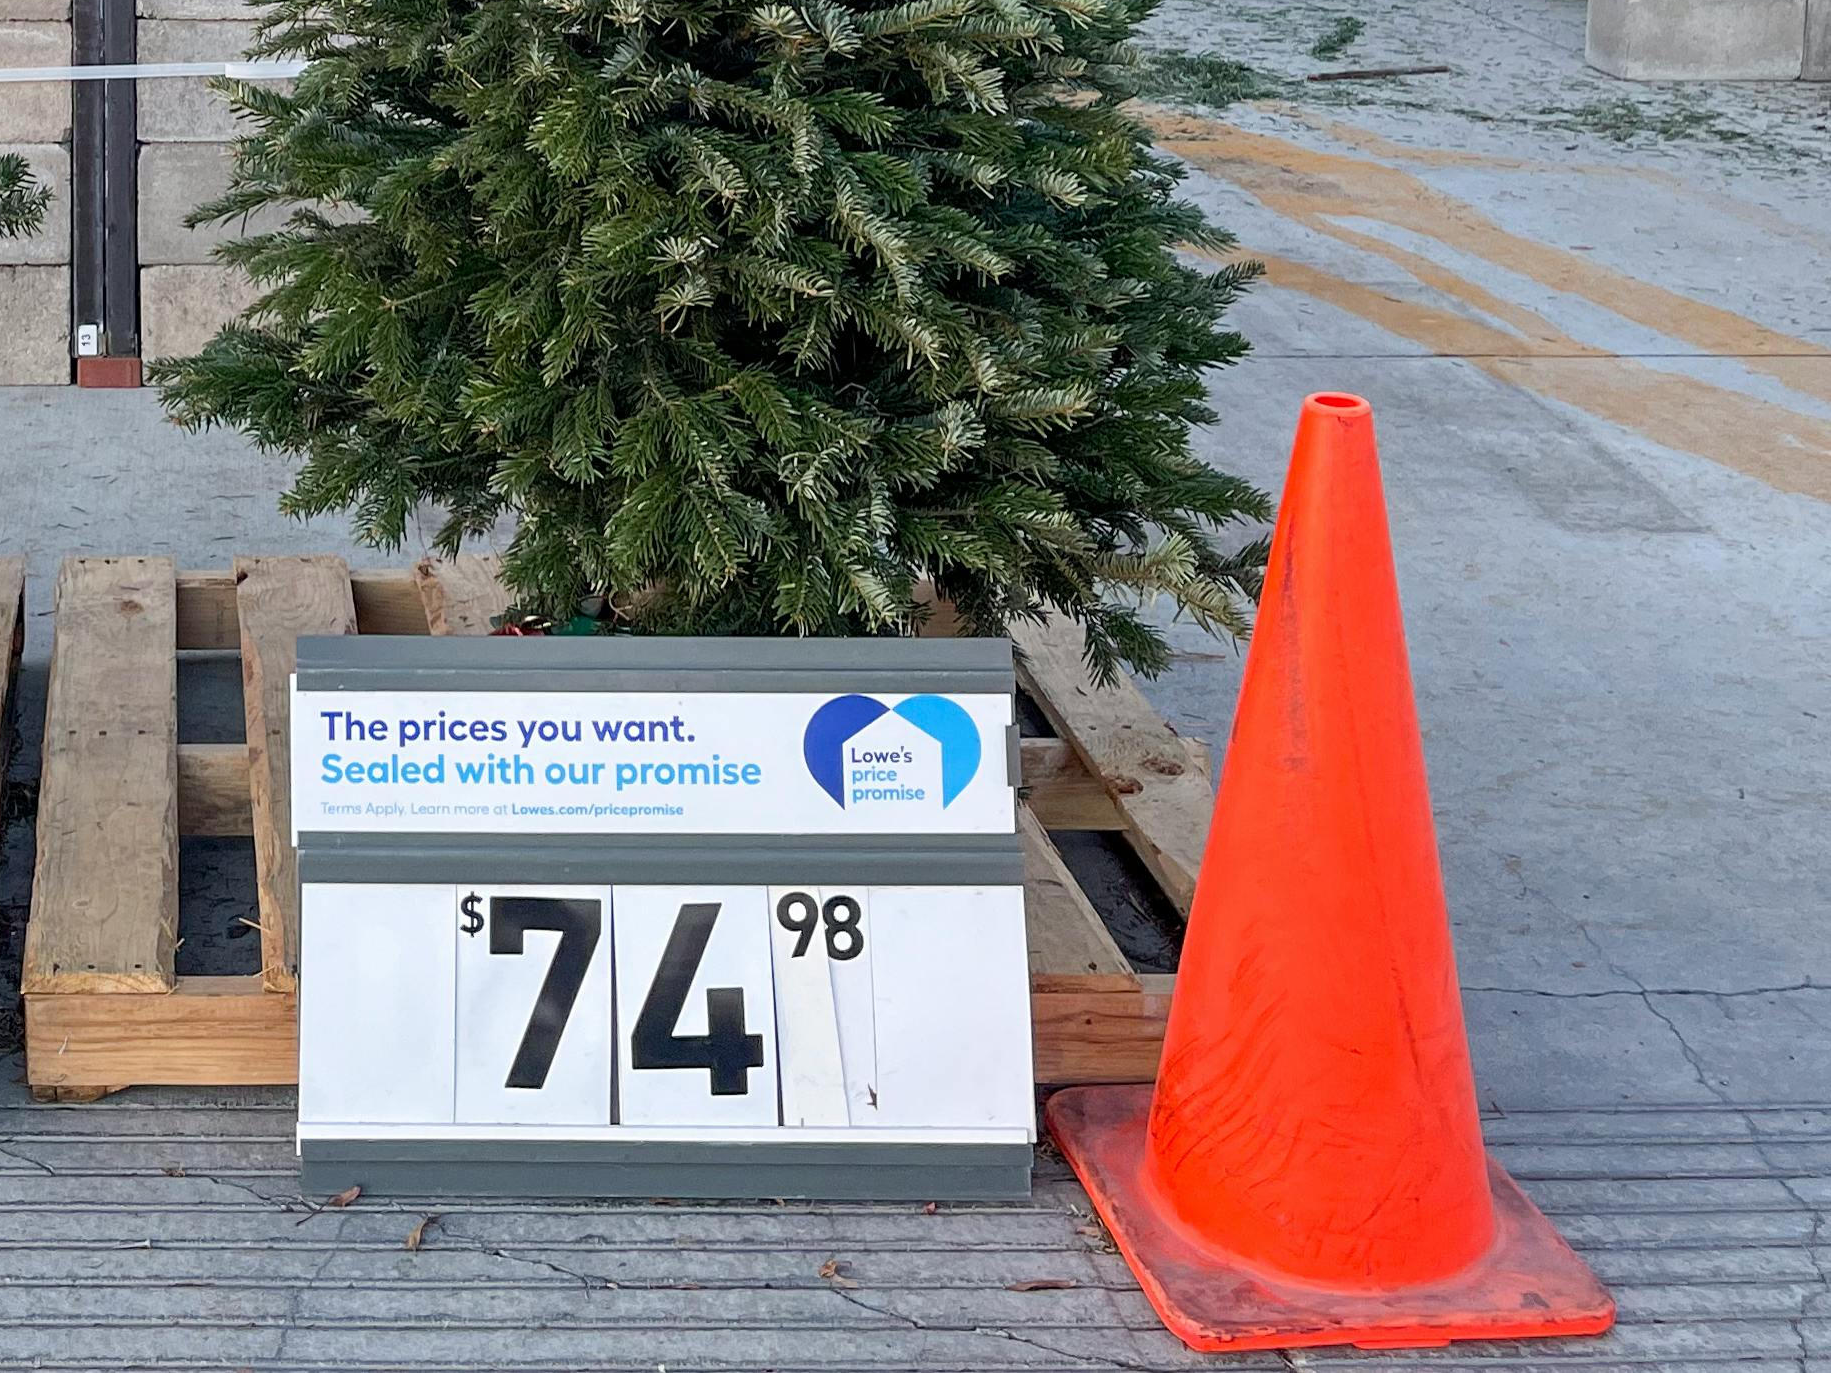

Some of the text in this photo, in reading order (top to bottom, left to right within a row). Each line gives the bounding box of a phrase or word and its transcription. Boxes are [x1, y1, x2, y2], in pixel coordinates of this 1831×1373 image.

[81, 333, 91, 347] 13
[320, 710, 696, 748] The prices you want.
[851, 745, 913, 764] Lowe's
[321, 752, 762, 792] Sealed with our promise
[852, 765, 898, 785] price
[852, 784, 926, 804] promise
[320, 801, 362, 815] Terms
[411, 802, 450, 815] Learn
[453, 804, 490, 815] more
[493, 803, 509, 815] at
[511, 803, 684, 818] Lowes.com/pricepromise
